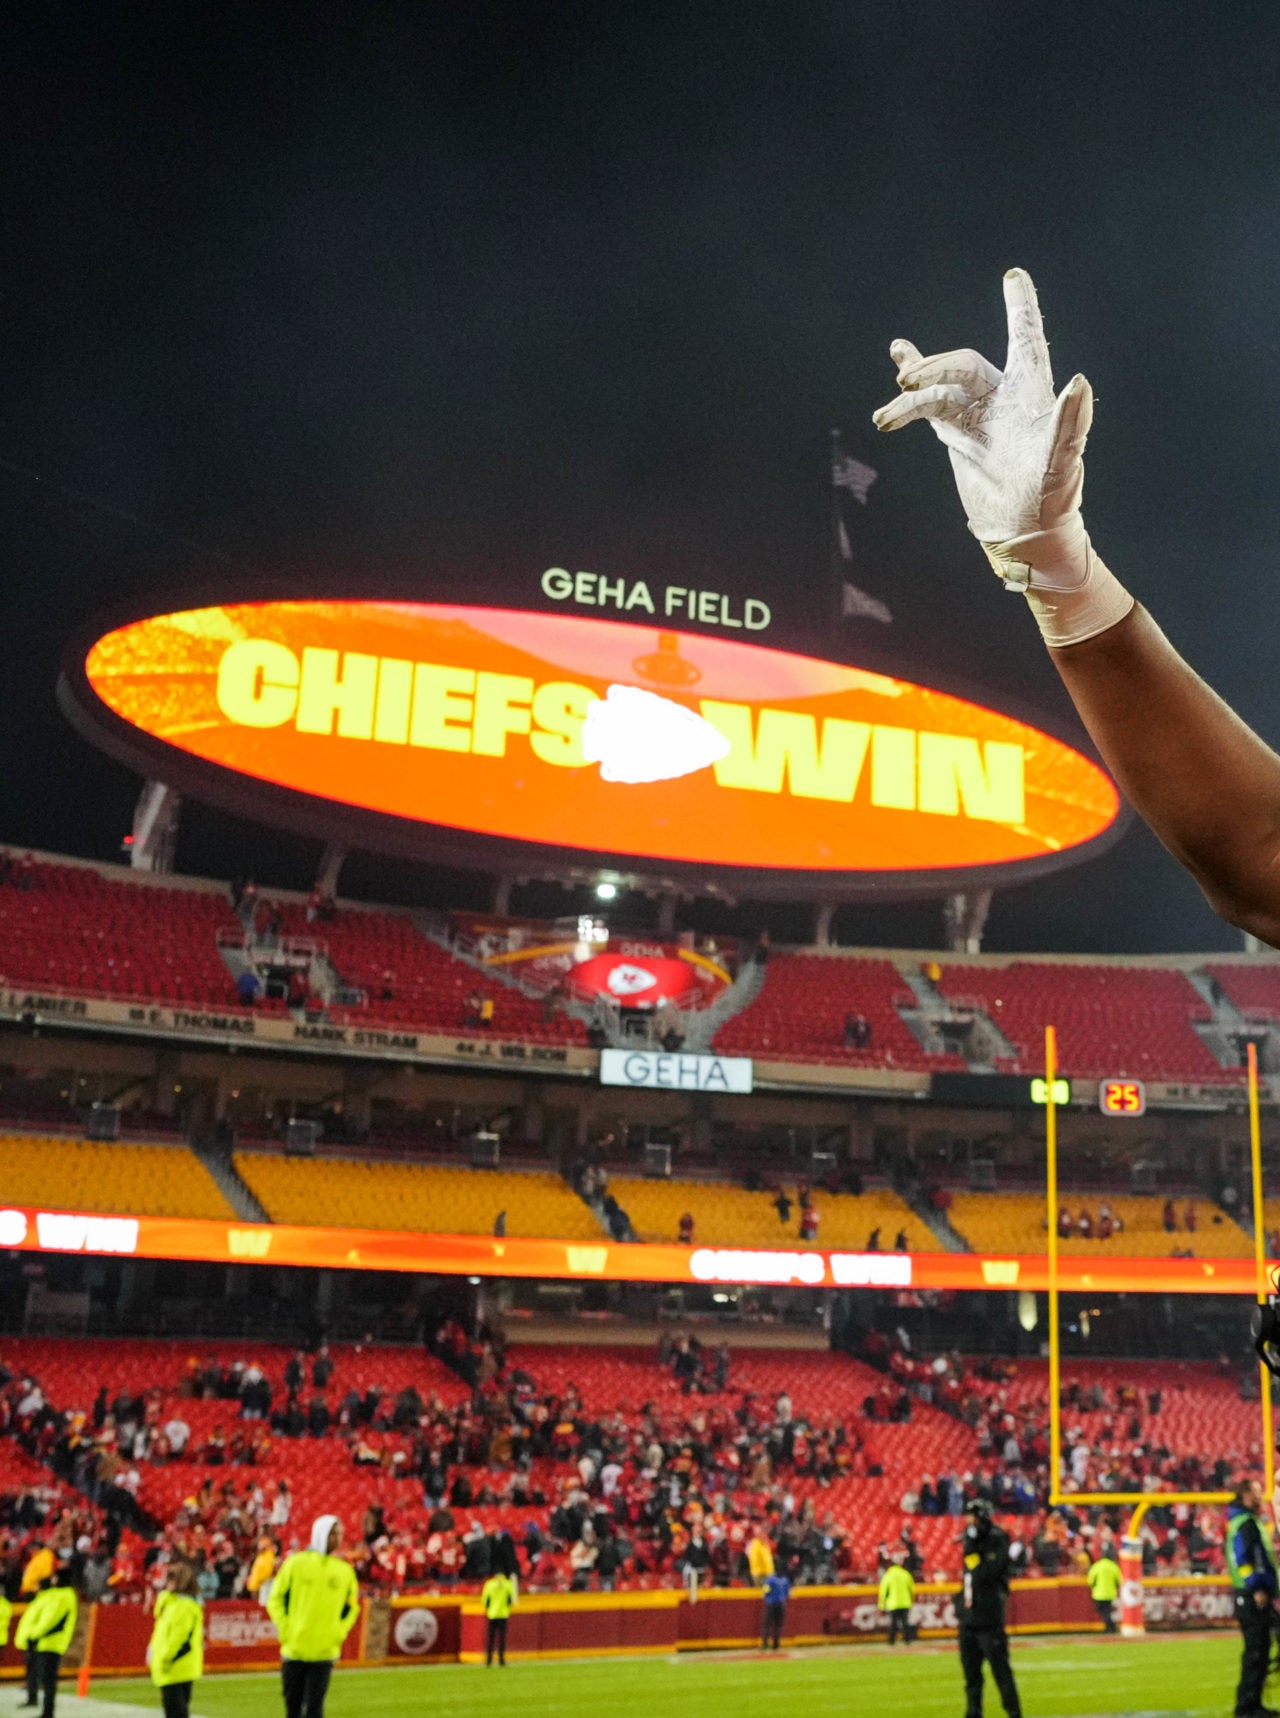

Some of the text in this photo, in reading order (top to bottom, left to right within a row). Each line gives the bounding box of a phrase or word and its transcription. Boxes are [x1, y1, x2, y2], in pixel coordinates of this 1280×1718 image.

[541, 567, 771, 630] GEHA FIELD
[216, 638, 1026, 824] CHIEFS WIN
[173, 1012, 255, 1033] THOMAS
[354, 1030, 418, 1049] STRAM
[623, 1053, 729, 1089] GEHA
[1105, 1083, 1140, 1112] 25
